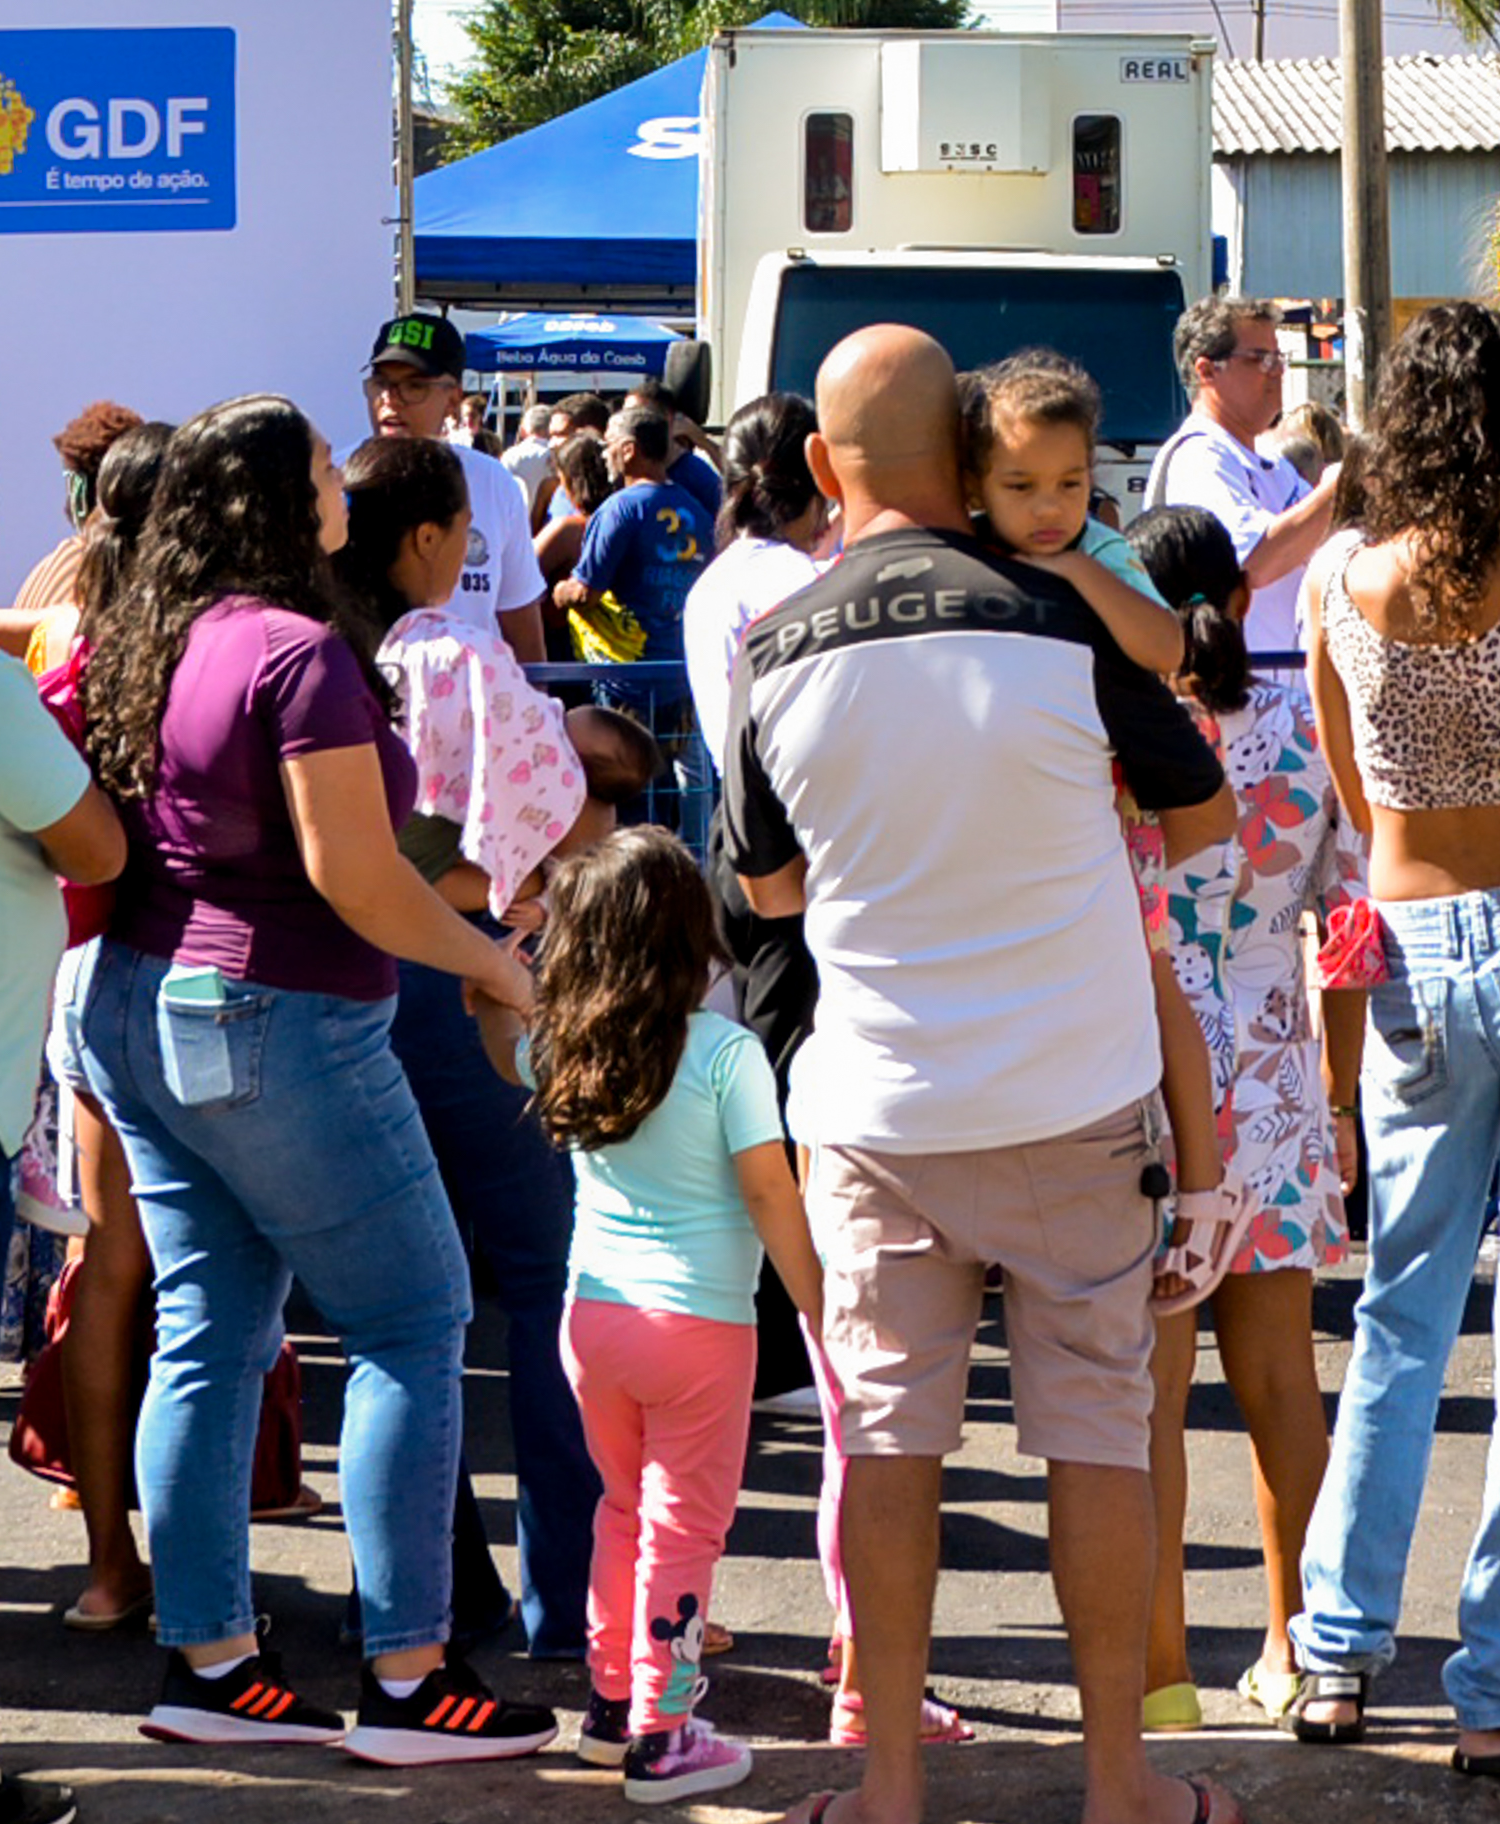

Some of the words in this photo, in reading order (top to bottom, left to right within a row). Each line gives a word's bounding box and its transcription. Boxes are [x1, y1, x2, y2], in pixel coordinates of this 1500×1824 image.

[1124, 60, 1187, 80] REAL
[44, 97, 209, 161] GDF
[46, 167, 60, 189] É
[64, 172, 126, 192] tempo
[129, 171, 154, 189] de
[156, 171, 210, 192] ação.
[775, 588, 1060, 655] PEUGEOT
